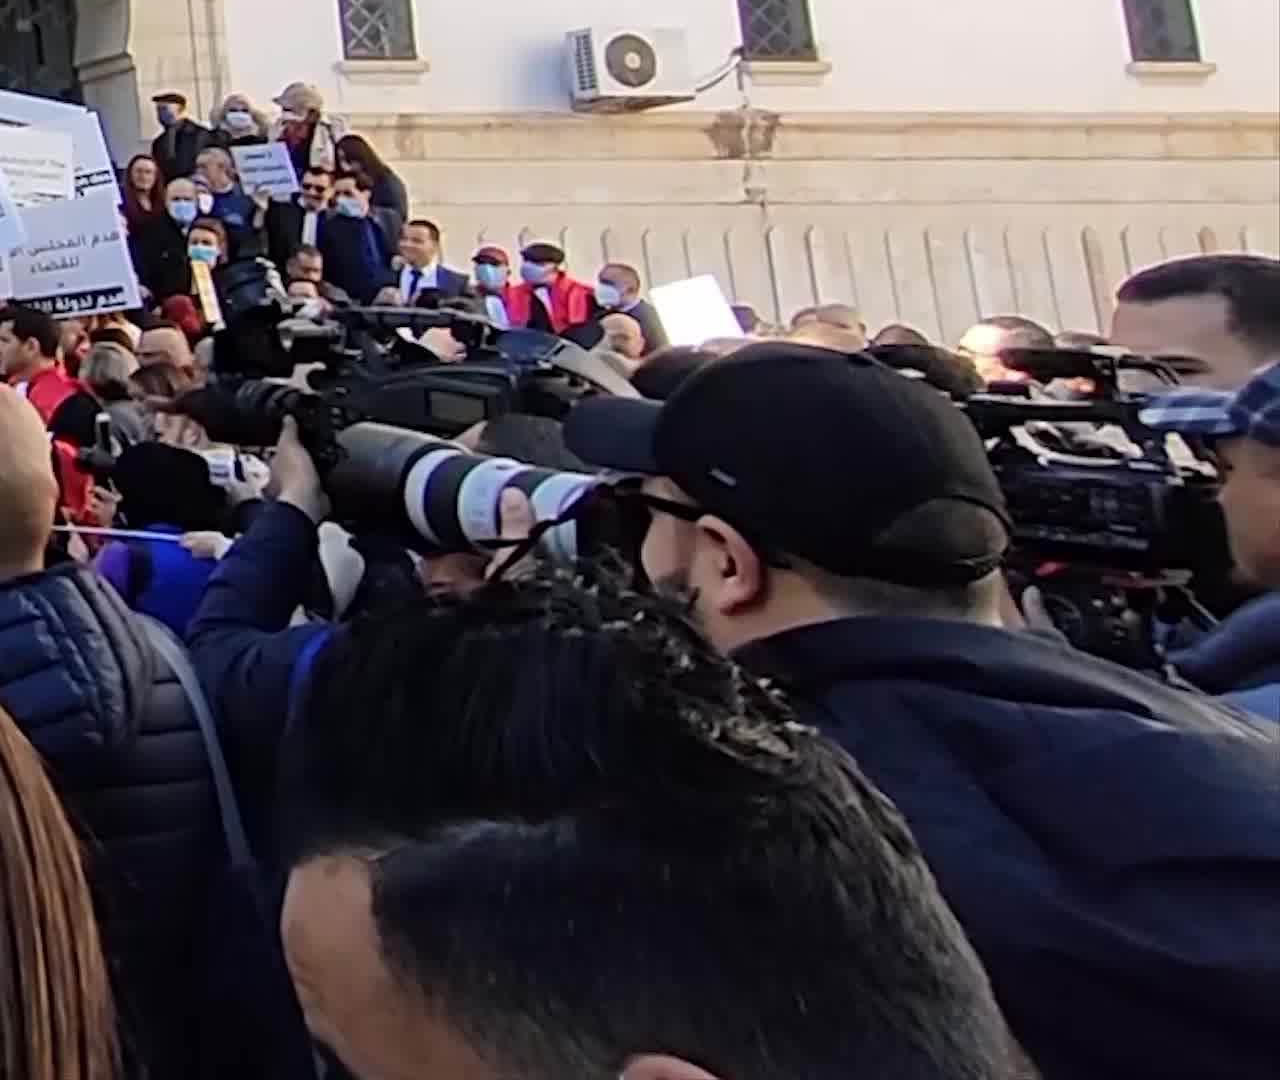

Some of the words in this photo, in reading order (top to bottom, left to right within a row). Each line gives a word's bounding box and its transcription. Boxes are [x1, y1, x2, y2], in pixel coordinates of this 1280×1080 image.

[27, 233, 87, 258] المجلس
[92, 231, 121, 248] هدم
[30, 255, 80, 274] للقضاء
